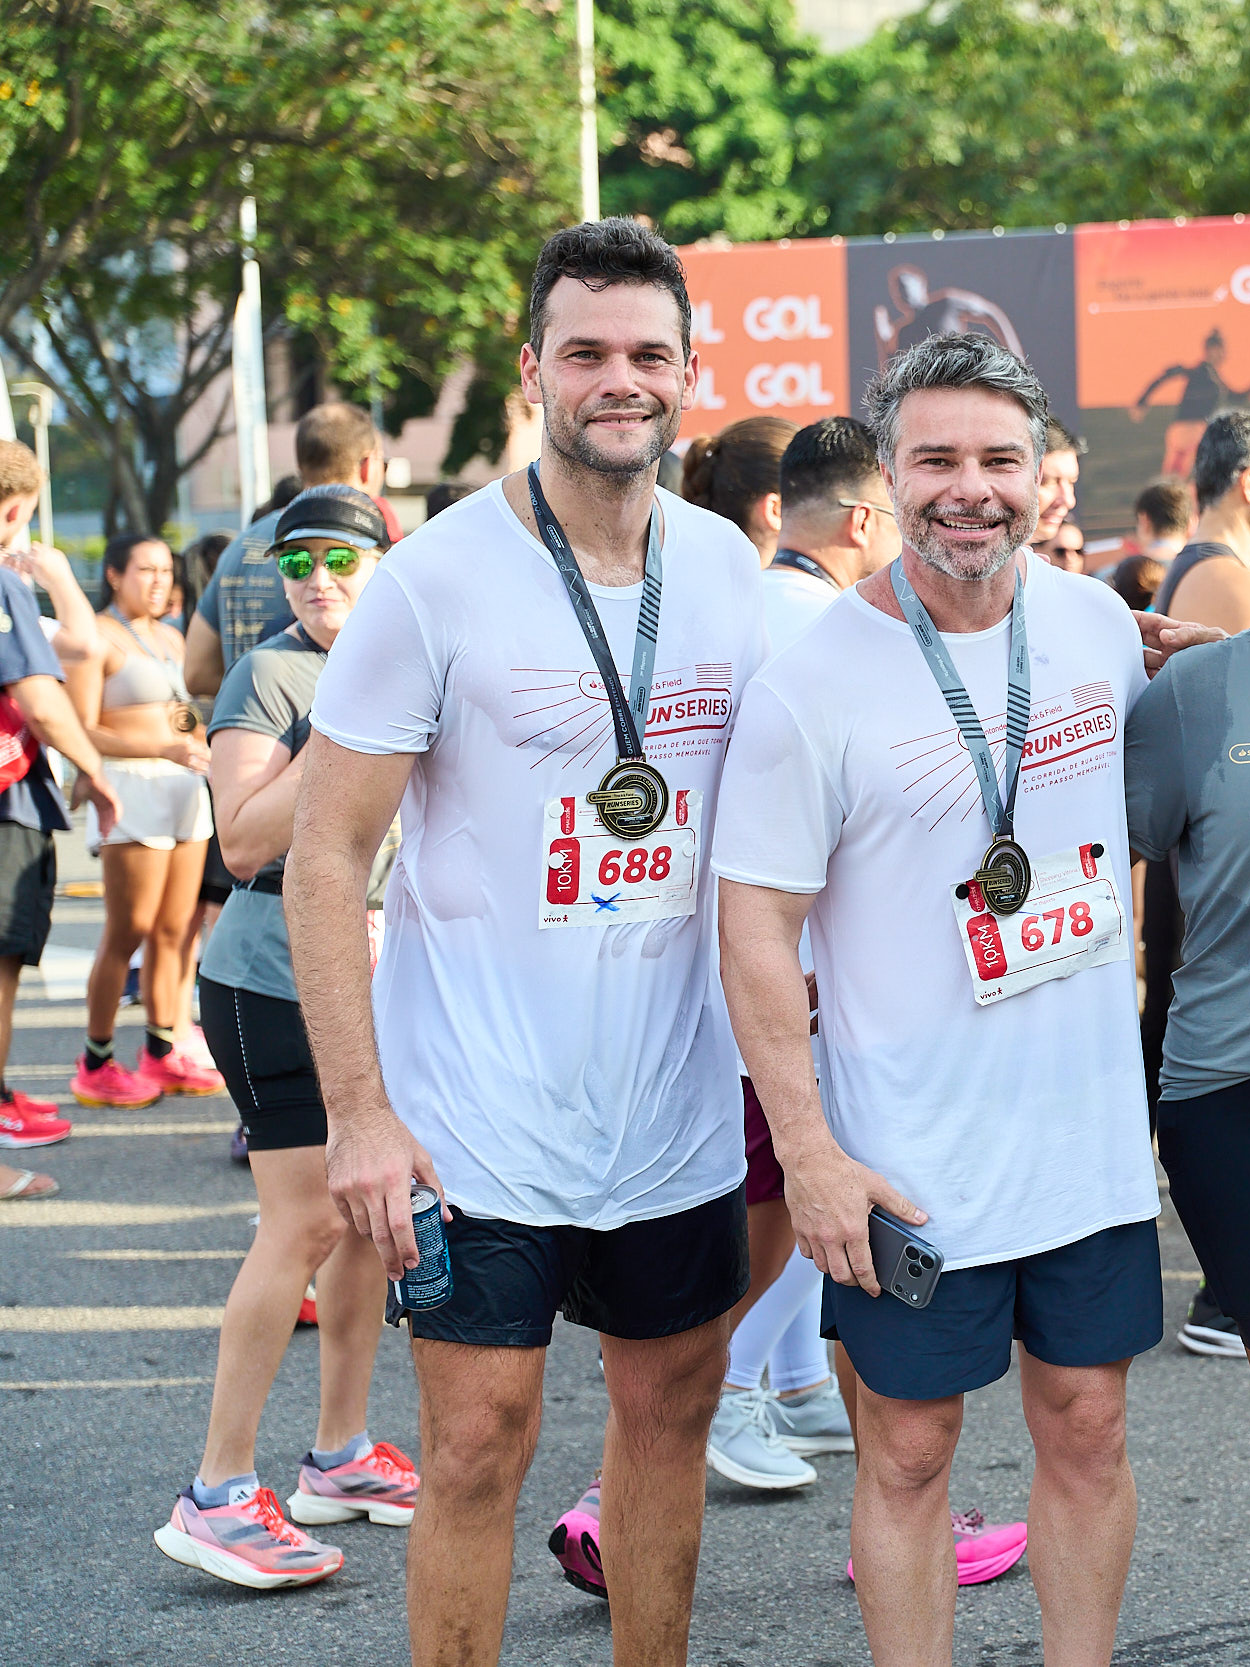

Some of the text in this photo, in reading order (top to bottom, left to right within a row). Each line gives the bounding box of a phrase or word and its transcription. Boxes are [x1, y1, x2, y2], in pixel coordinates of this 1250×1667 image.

[742, 294, 833, 342] GOL
[744, 361, 834, 409] GOL
[662, 678, 682, 689] Field
[645, 698, 728, 726] UNSERIES
[1045, 705, 1063, 716] Field
[984, 724, 1007, 736] ntande
[641, 743, 667, 751] RRIDA
[1031, 767, 1066, 782] CORRIDA
[1081, 758, 1093, 766] RUA
[1024, 783, 1046, 794] CADA
[1049, 774, 1074, 786] PASSO
[557, 849, 573, 892] 10KM
[598, 846, 672, 885] 688
[543, 915, 561, 923] vivo
[1021, 901, 1094, 952] 678
[977, 924, 1000, 968] 10KM
[980, 989, 997, 999] vivo
